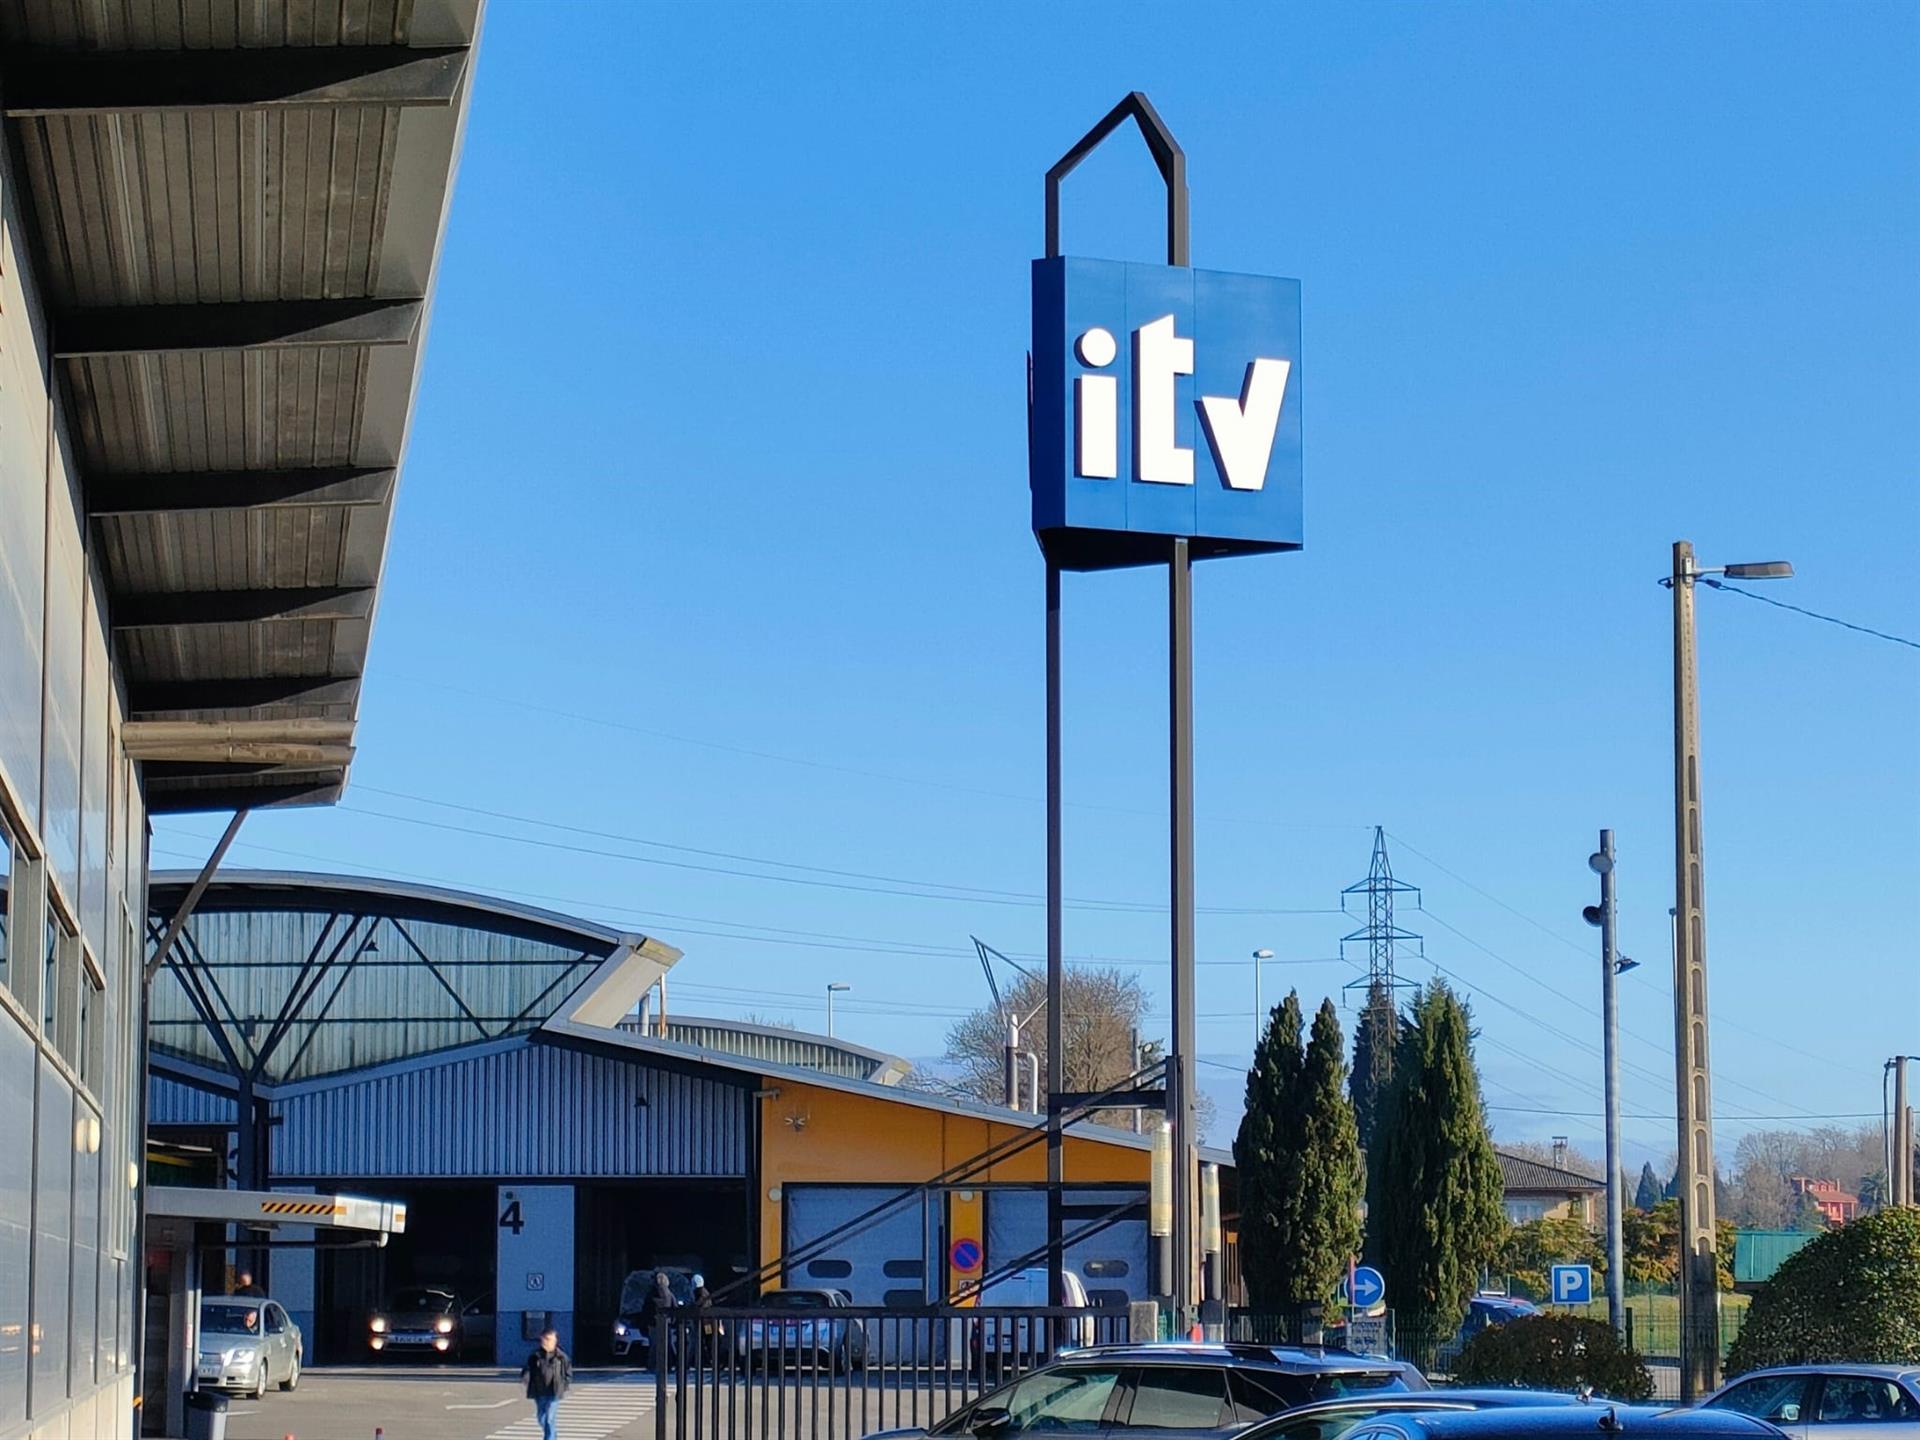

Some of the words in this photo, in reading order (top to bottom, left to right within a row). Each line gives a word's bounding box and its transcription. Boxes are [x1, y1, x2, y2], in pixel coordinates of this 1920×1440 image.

[1076, 314, 1290, 491] itv
[500, 1201, 524, 1234] 4
[1560, 1270, 1582, 1299] P
